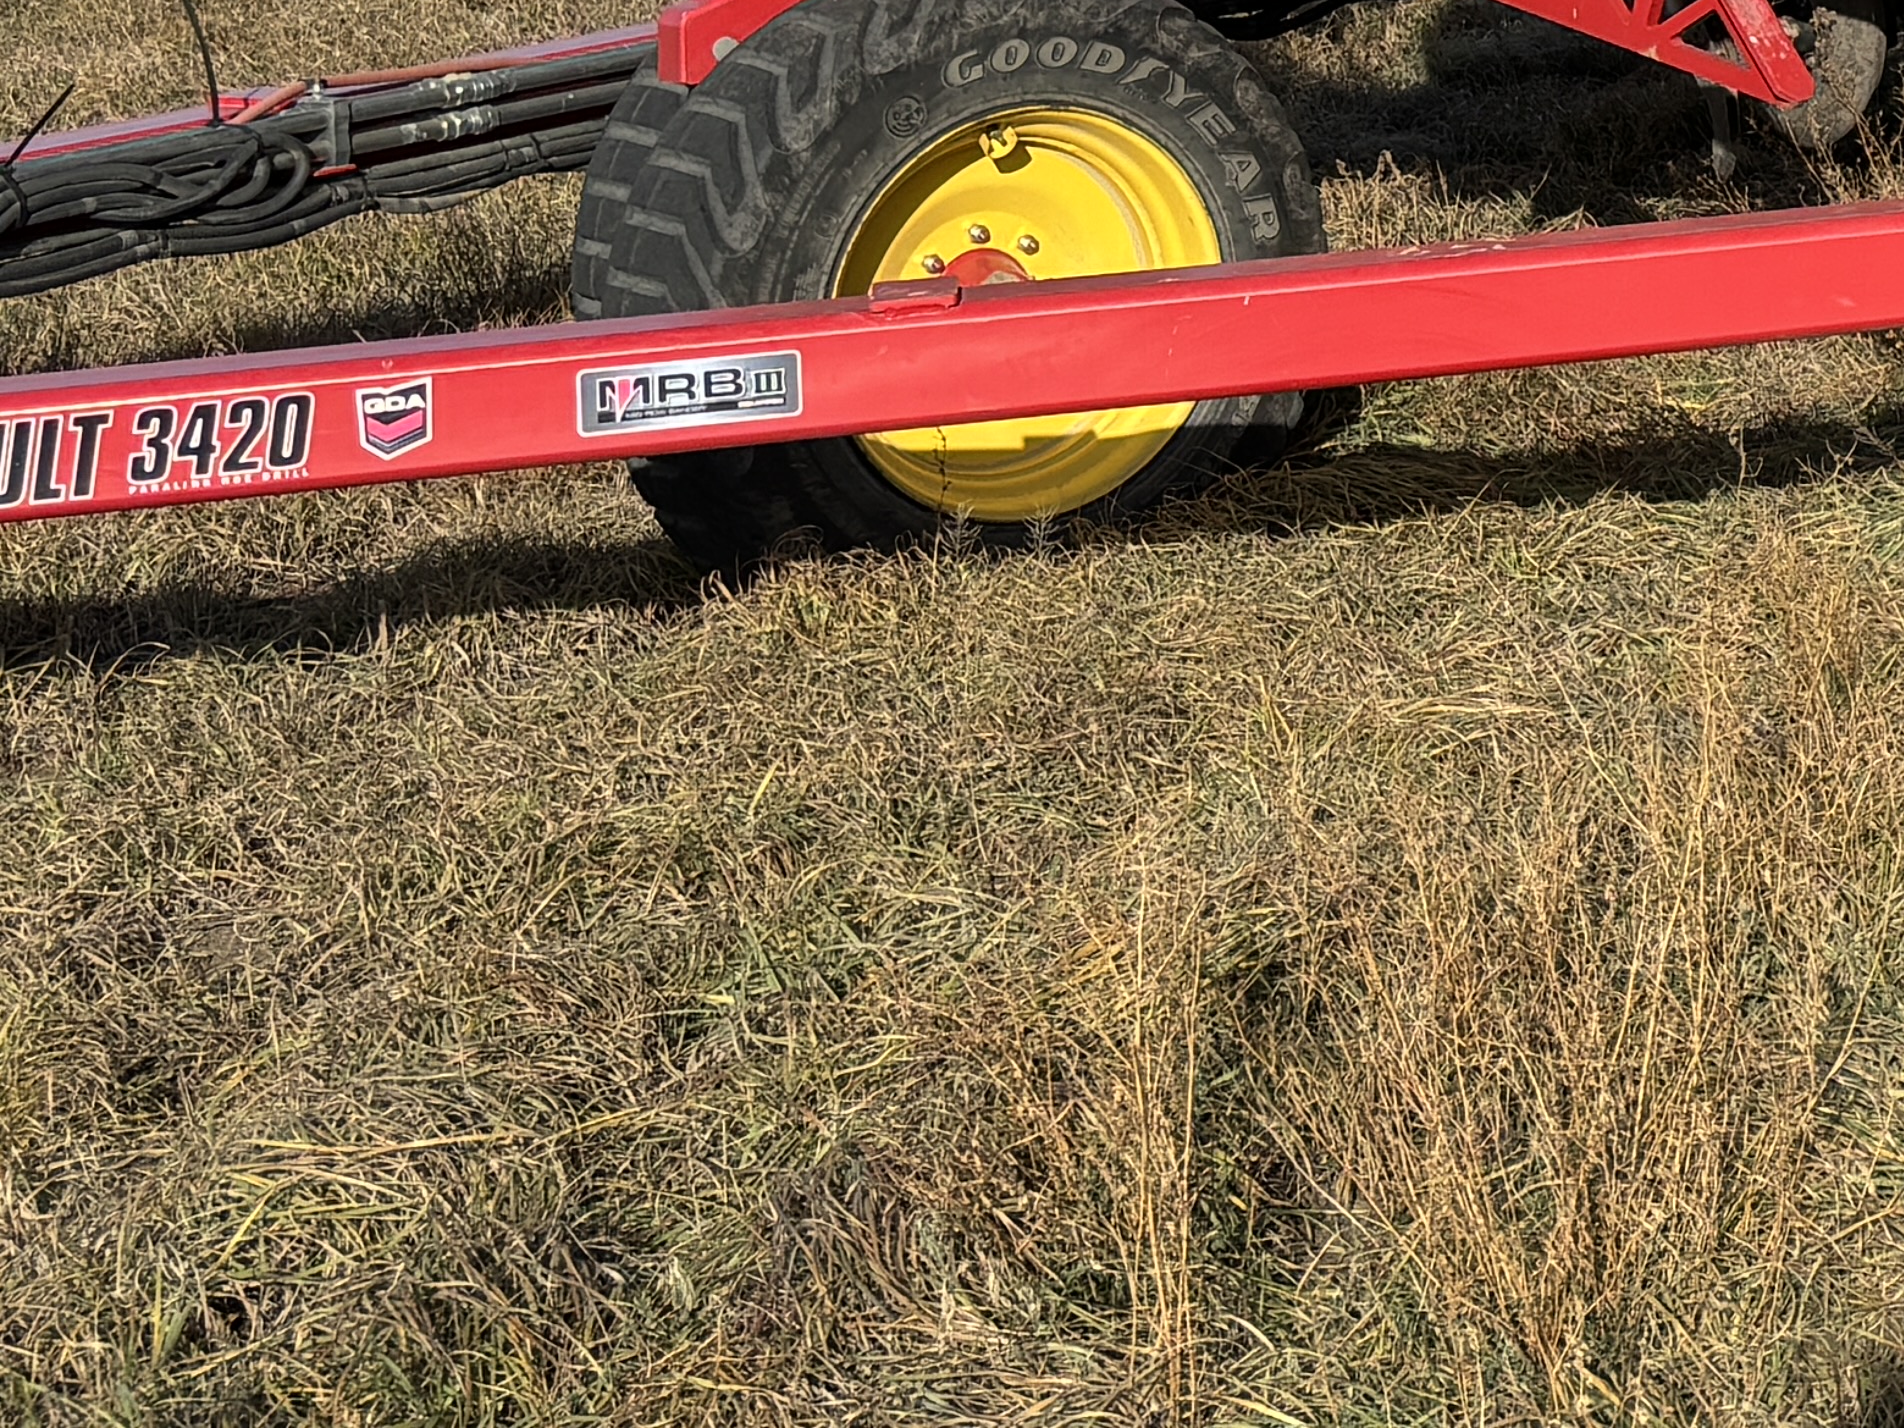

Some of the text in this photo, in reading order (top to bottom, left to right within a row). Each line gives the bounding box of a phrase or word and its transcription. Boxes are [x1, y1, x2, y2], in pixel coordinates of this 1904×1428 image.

[942, 36, 1282, 243] GOODYEAR
[126, 391, 316, 485] 3420
[596, 366, 746, 418] MRB
